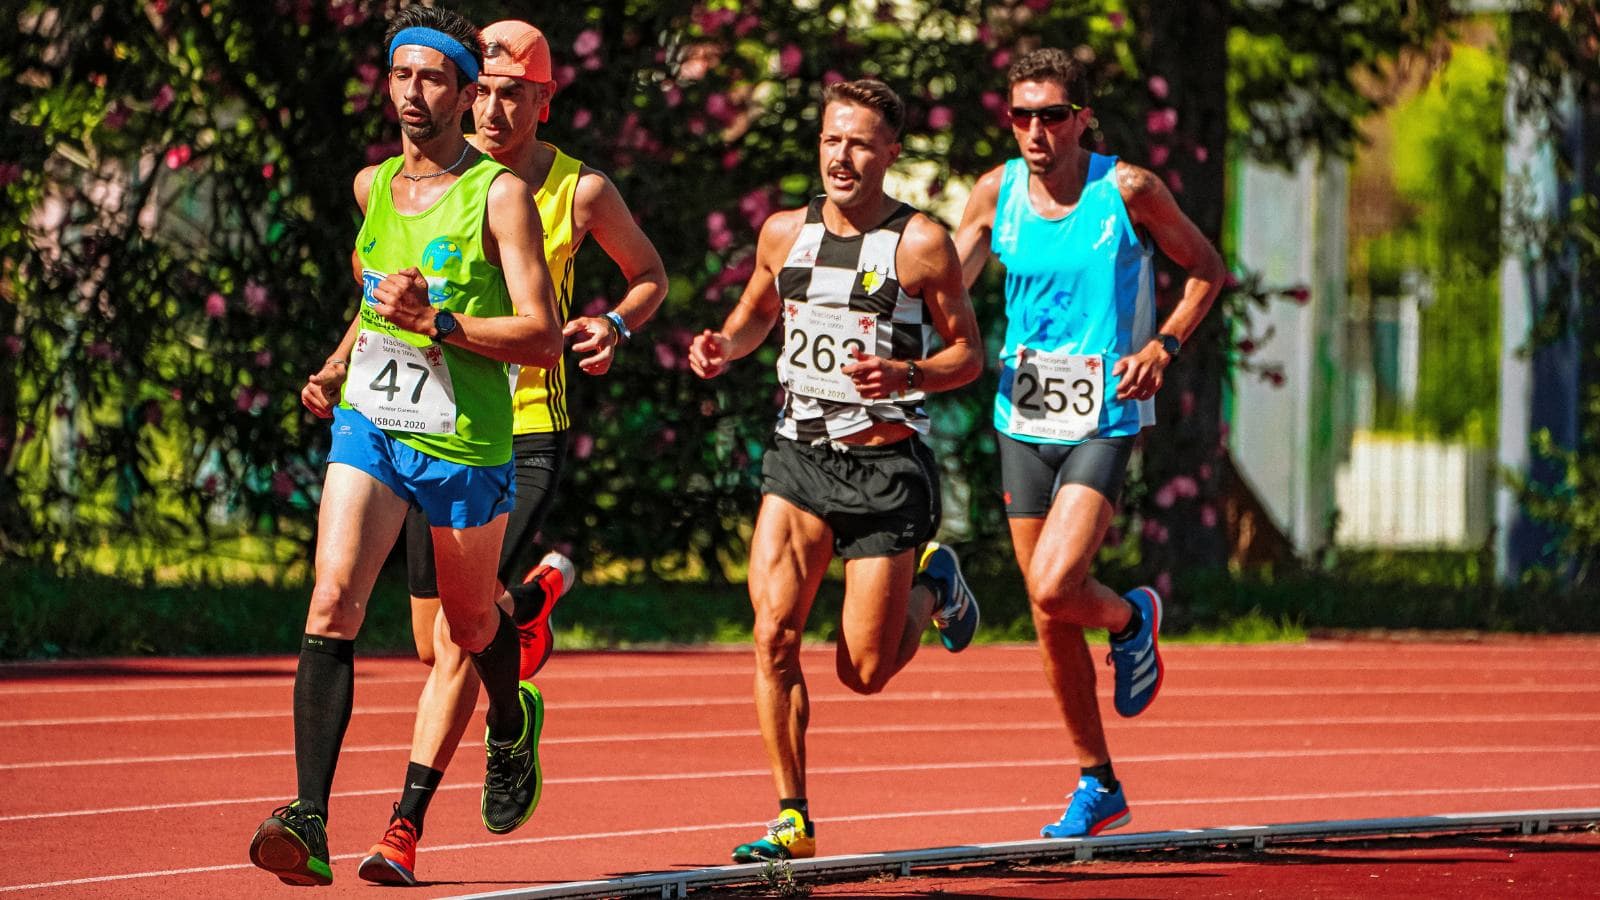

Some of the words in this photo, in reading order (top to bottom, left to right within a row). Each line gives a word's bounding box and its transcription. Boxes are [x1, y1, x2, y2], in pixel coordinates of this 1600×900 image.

[369, 358, 430, 405] 47
[800, 384, 825, 395] LISBOA
[827, 389, 846, 398] 2020
[1018, 373, 1095, 416] 253
[370, 417, 402, 428] LISBOA
[404, 420, 426, 430] 2020
